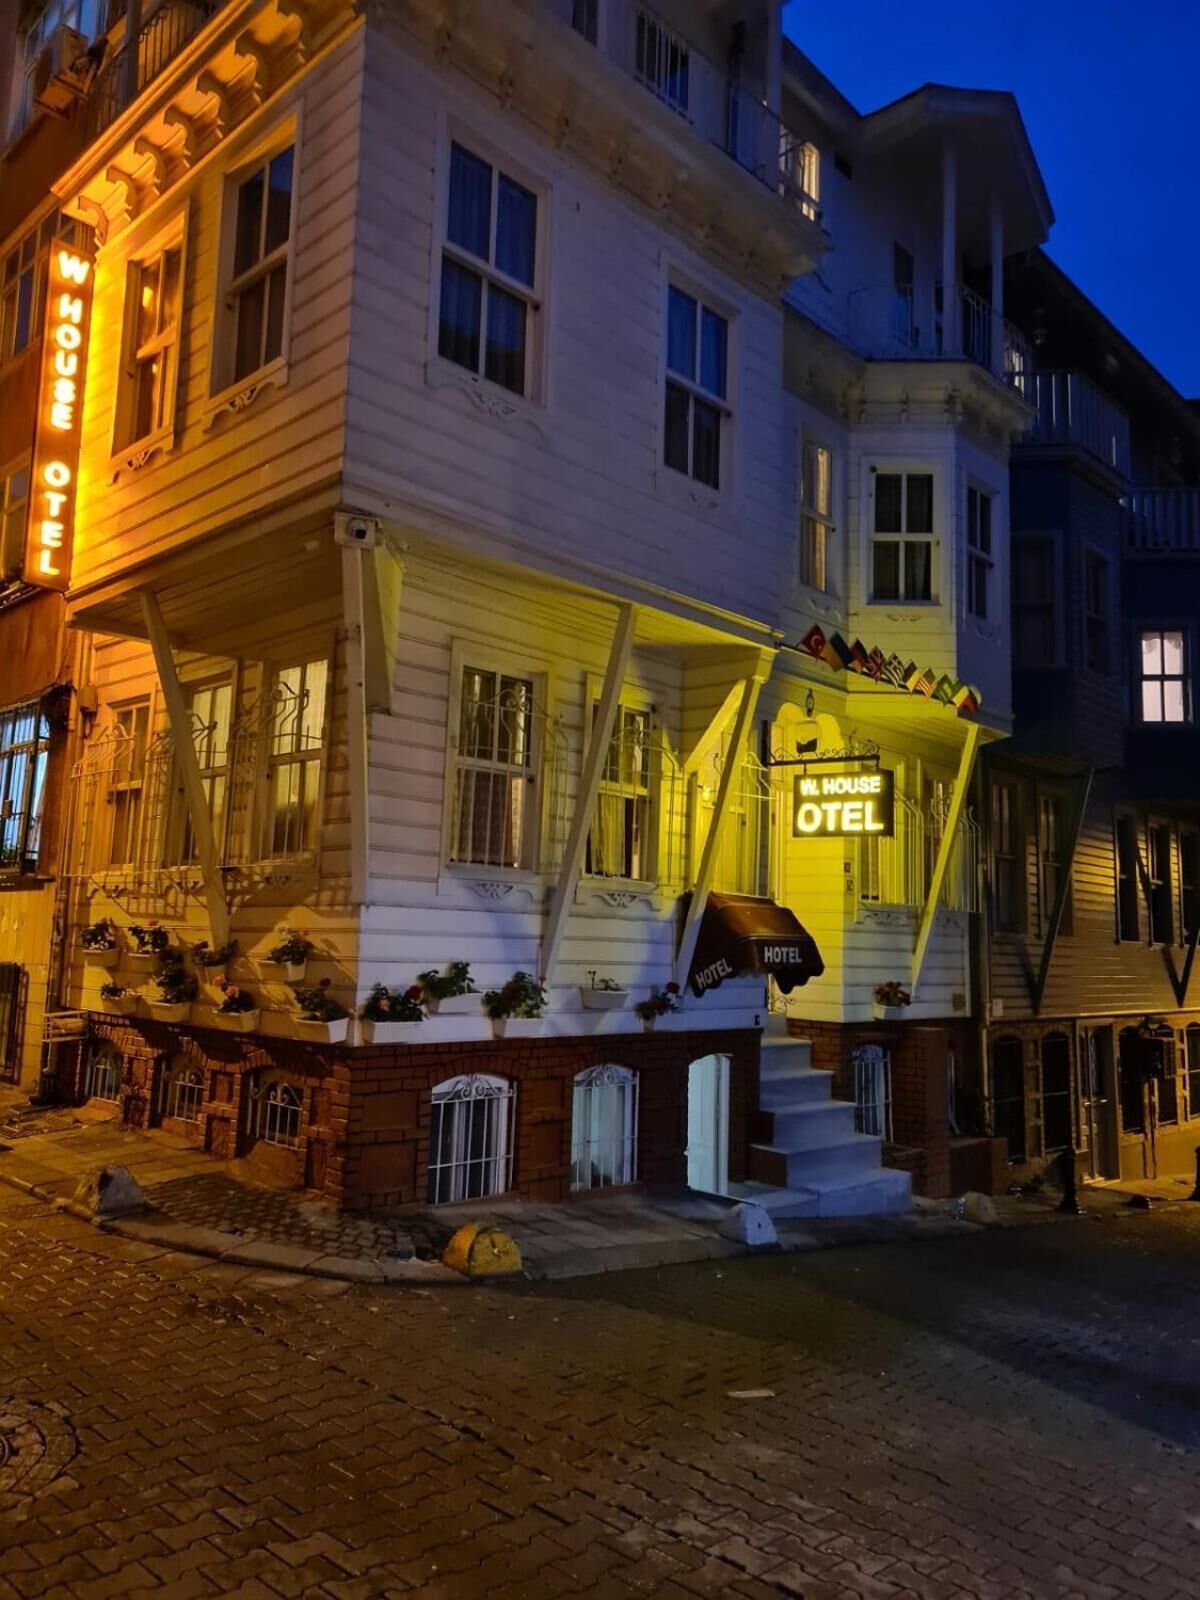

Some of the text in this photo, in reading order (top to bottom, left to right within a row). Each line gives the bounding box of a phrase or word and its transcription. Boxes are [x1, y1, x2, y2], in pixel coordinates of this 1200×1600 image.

[39, 251, 90, 575] W HOUSE OTEL
[800, 775, 881, 796] W. HOUSE
[797, 801, 884, 832] OTEL
[764, 946, 802, 963] HOTEL
[695, 957, 733, 989] HOTEL
